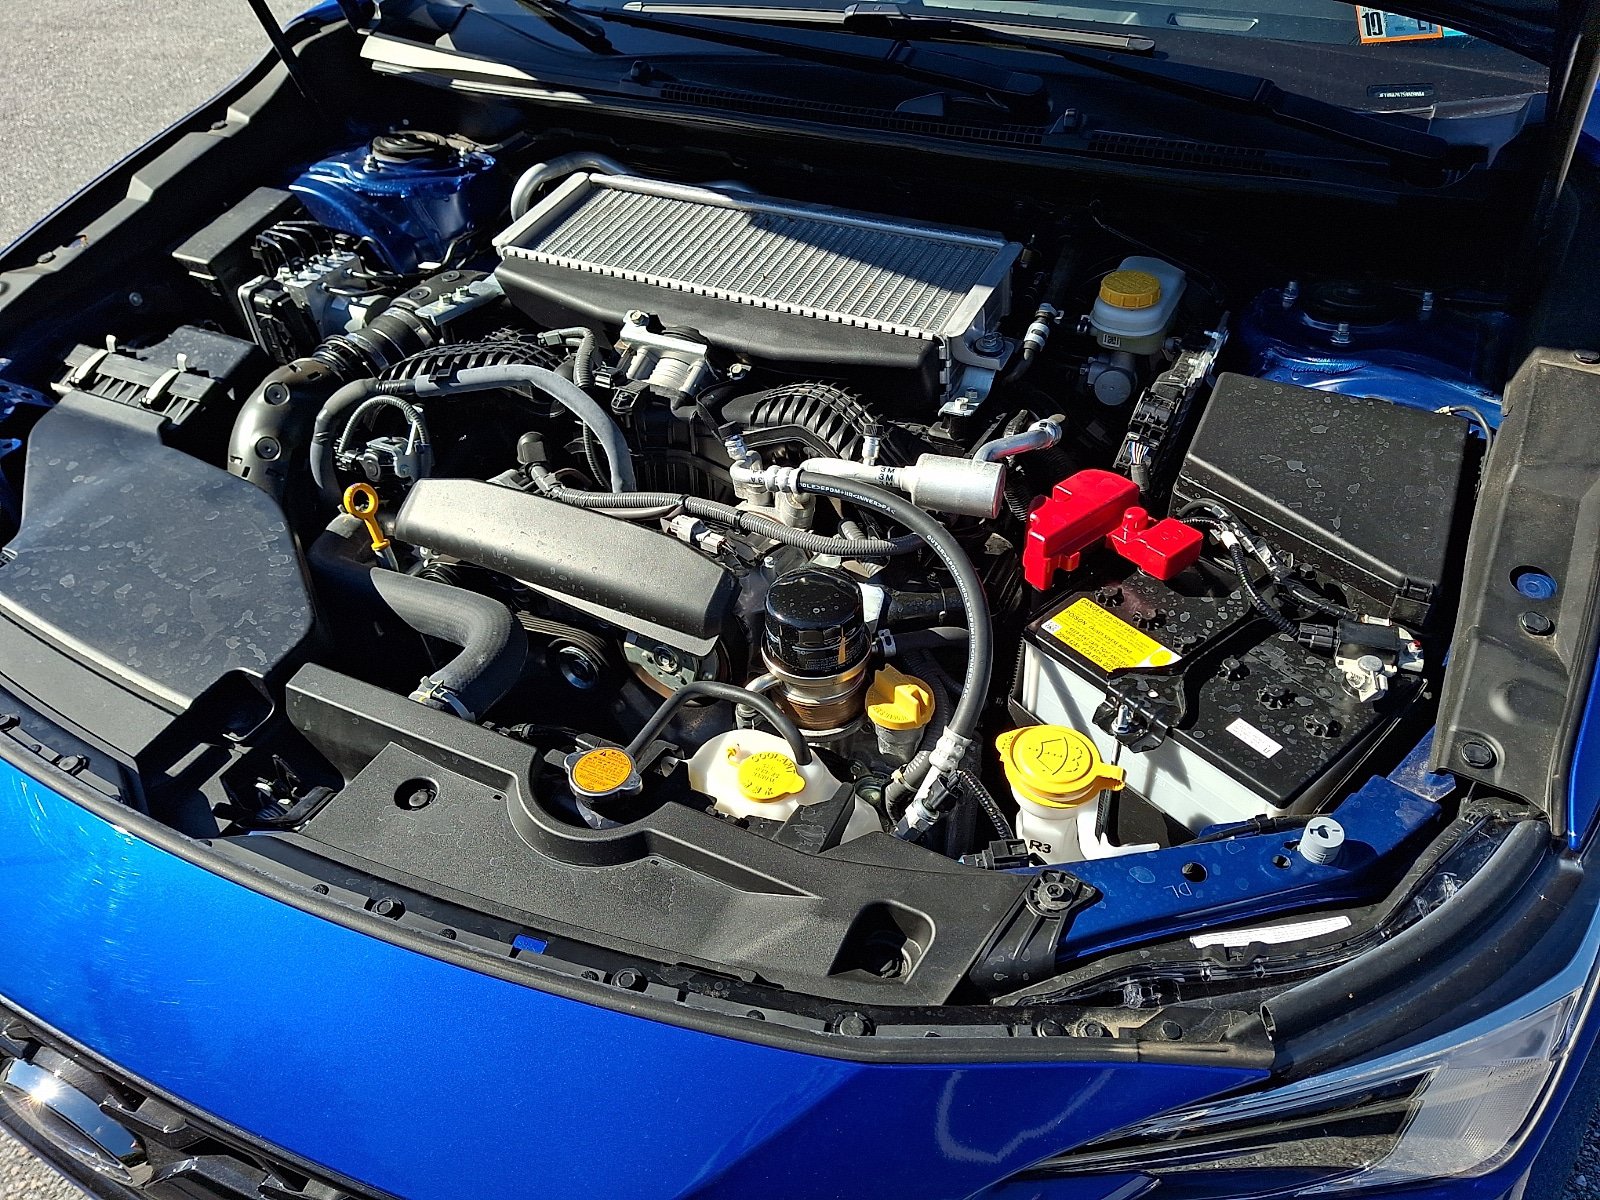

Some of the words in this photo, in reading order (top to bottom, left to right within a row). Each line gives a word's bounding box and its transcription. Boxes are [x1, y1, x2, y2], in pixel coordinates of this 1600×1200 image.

[1079, 599, 1105, 615] DANGER
[1064, 609, 1088, 625] POISON
[1029, 839, 1052, 854] R3
